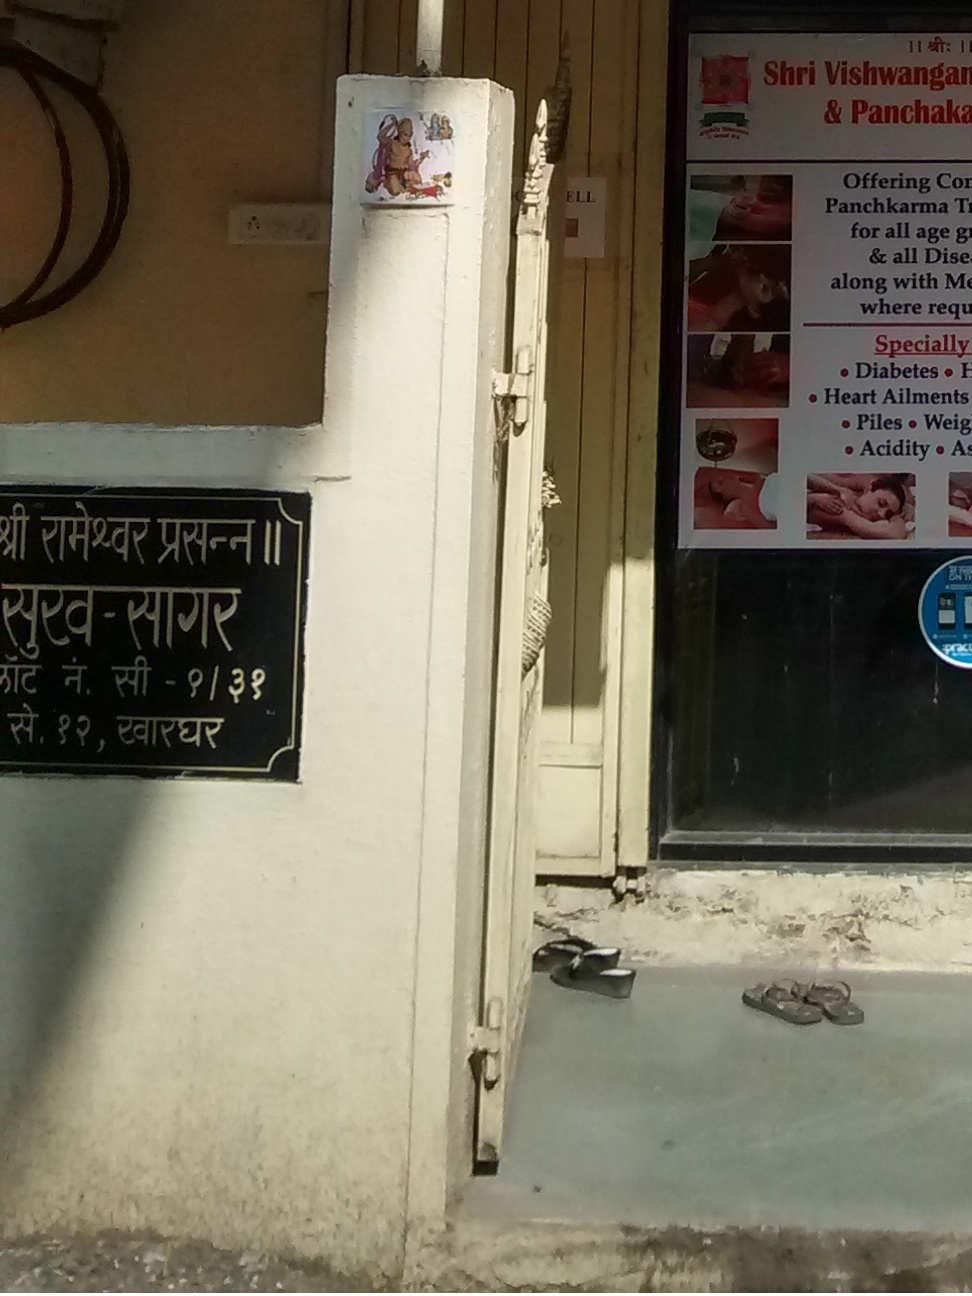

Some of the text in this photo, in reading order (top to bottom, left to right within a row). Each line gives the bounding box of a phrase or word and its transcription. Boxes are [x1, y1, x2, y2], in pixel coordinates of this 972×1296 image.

[763, 60, 816, 86] Shri
[823, 100, 842, 124] &
[843, 172, 930, 194] Offering
[565, 191, 596, 203] ELL
[824, 198, 949, 216] Panchkarma
[851, 222, 880, 241] for
[884, 222, 909, 240] all
[916, 226, 951, 245] age
[830, 274, 887, 294] along
[893, 274, 939, 291] with
[860, 299, 922, 316] where
[875, 334, 970, 357] Specially
[855, 362, 939, 380] Diabetes
[824, 388, 879, 405] Heart
[882, 388, 969, 405] Ailments
[856, 414, 903, 432] Piles
[859, 439, 931, 459] Acidity
[40, 501, 151, 564] रामेश्वर
[157, 518, 256, 566] प्रसन्न
[111, 655, 152, 697] सी
[116, 716, 225, 749] खारघर
